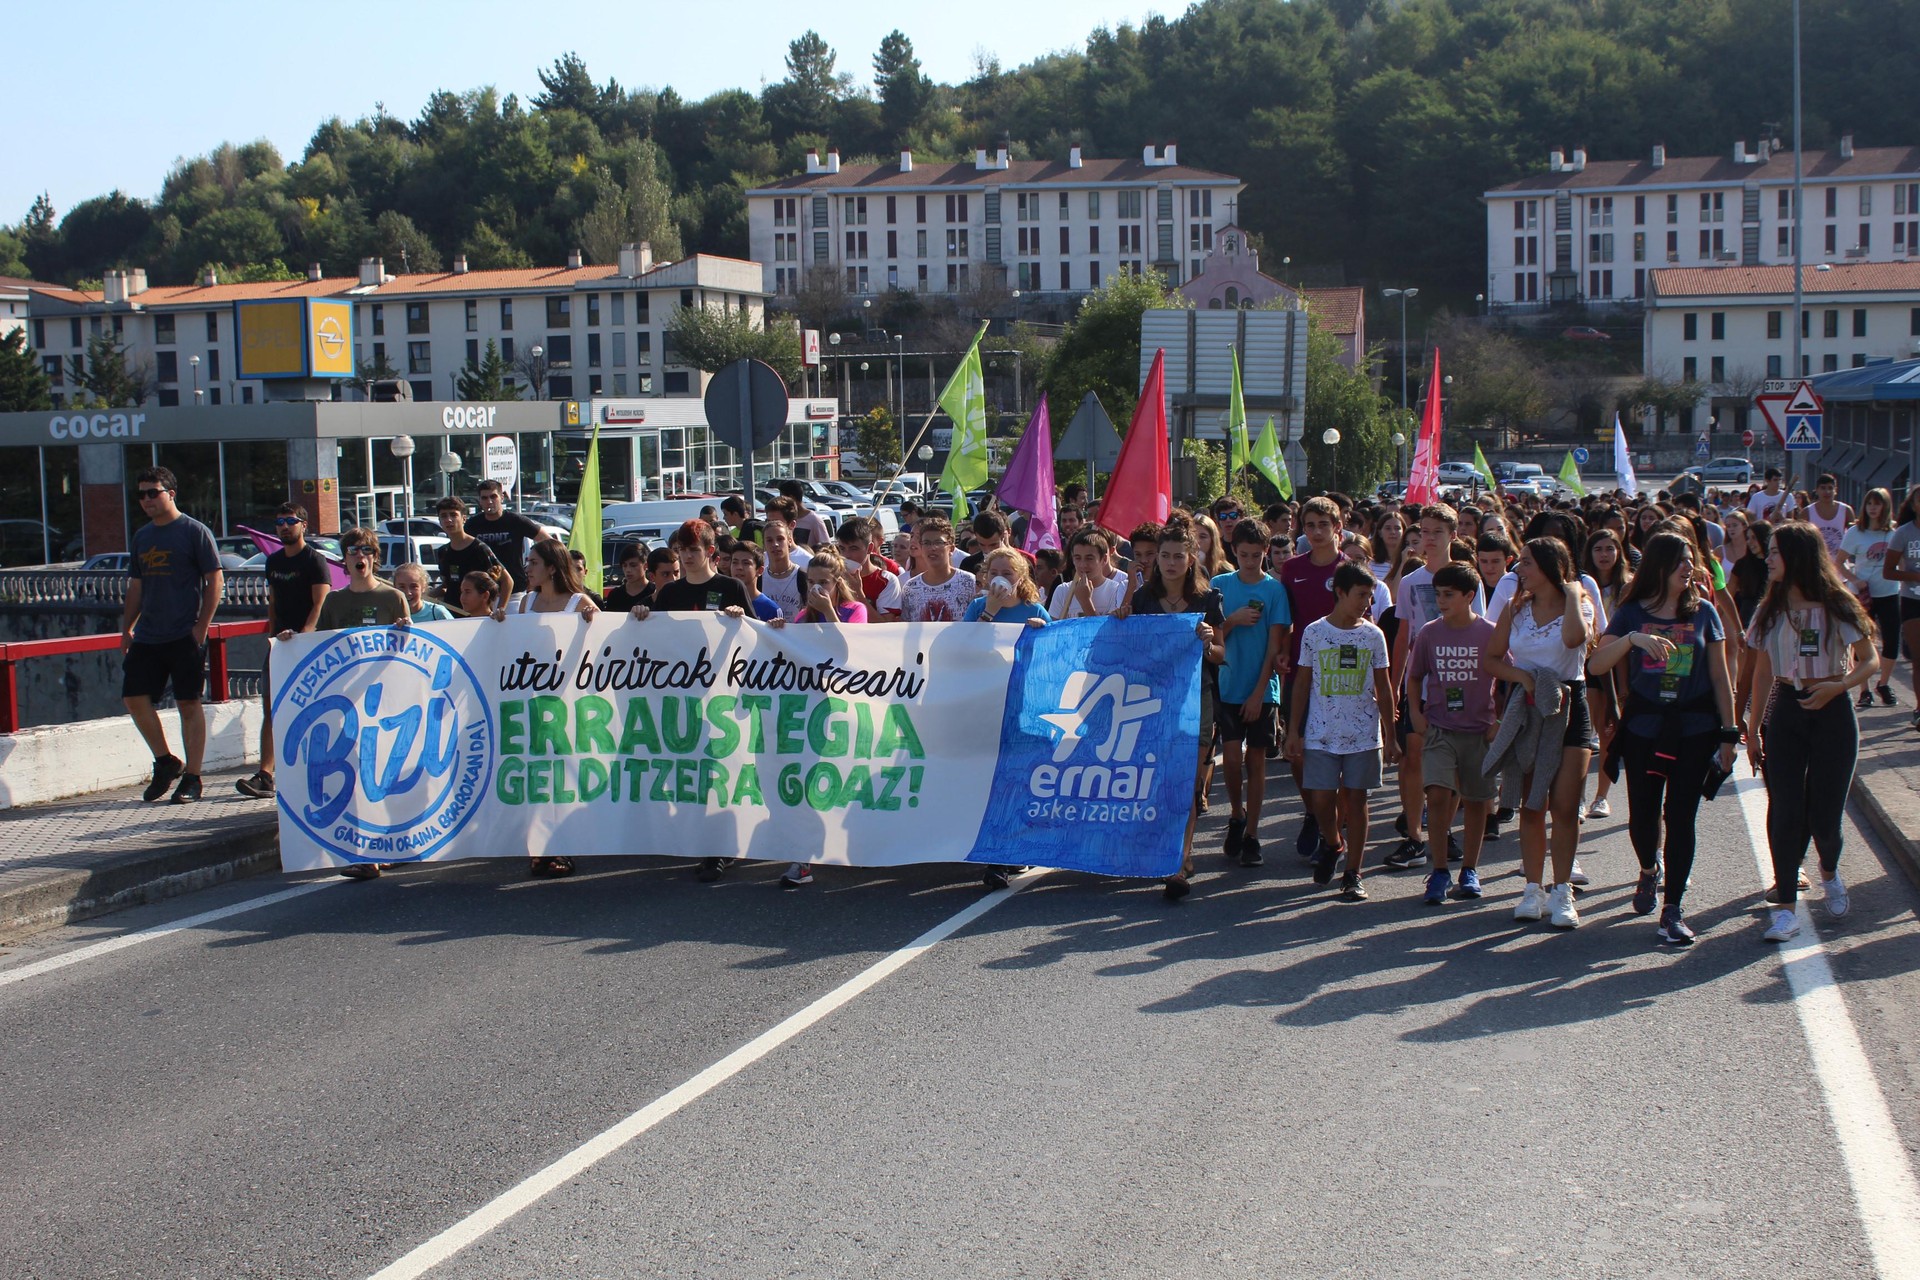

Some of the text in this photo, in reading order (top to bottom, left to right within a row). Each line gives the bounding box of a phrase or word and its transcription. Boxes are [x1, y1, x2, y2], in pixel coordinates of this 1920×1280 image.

[1765, 382, 1784, 391] STOP
[50, 412, 145, 439] cocar
[443, 406, 496, 428] cocar
[1436, 646, 1478, 657] UNDE
[291, 633, 434, 709] EUSKAL HERRIAN
[1438, 671, 1478, 681] TROL
[283, 655, 458, 829] Bizi
[500, 694, 926, 760] ERRAUSTEGIA
[497, 756, 926, 812] GELDITZERA GOAZ!
[1030, 752, 1156, 800] ernai
[334, 825, 393, 852] GAZTEON
[396, 825, 442, 852] ORAINA
[438, 754, 484, 829] BORROKAN
[1027, 798, 1157, 823] aske izateko
